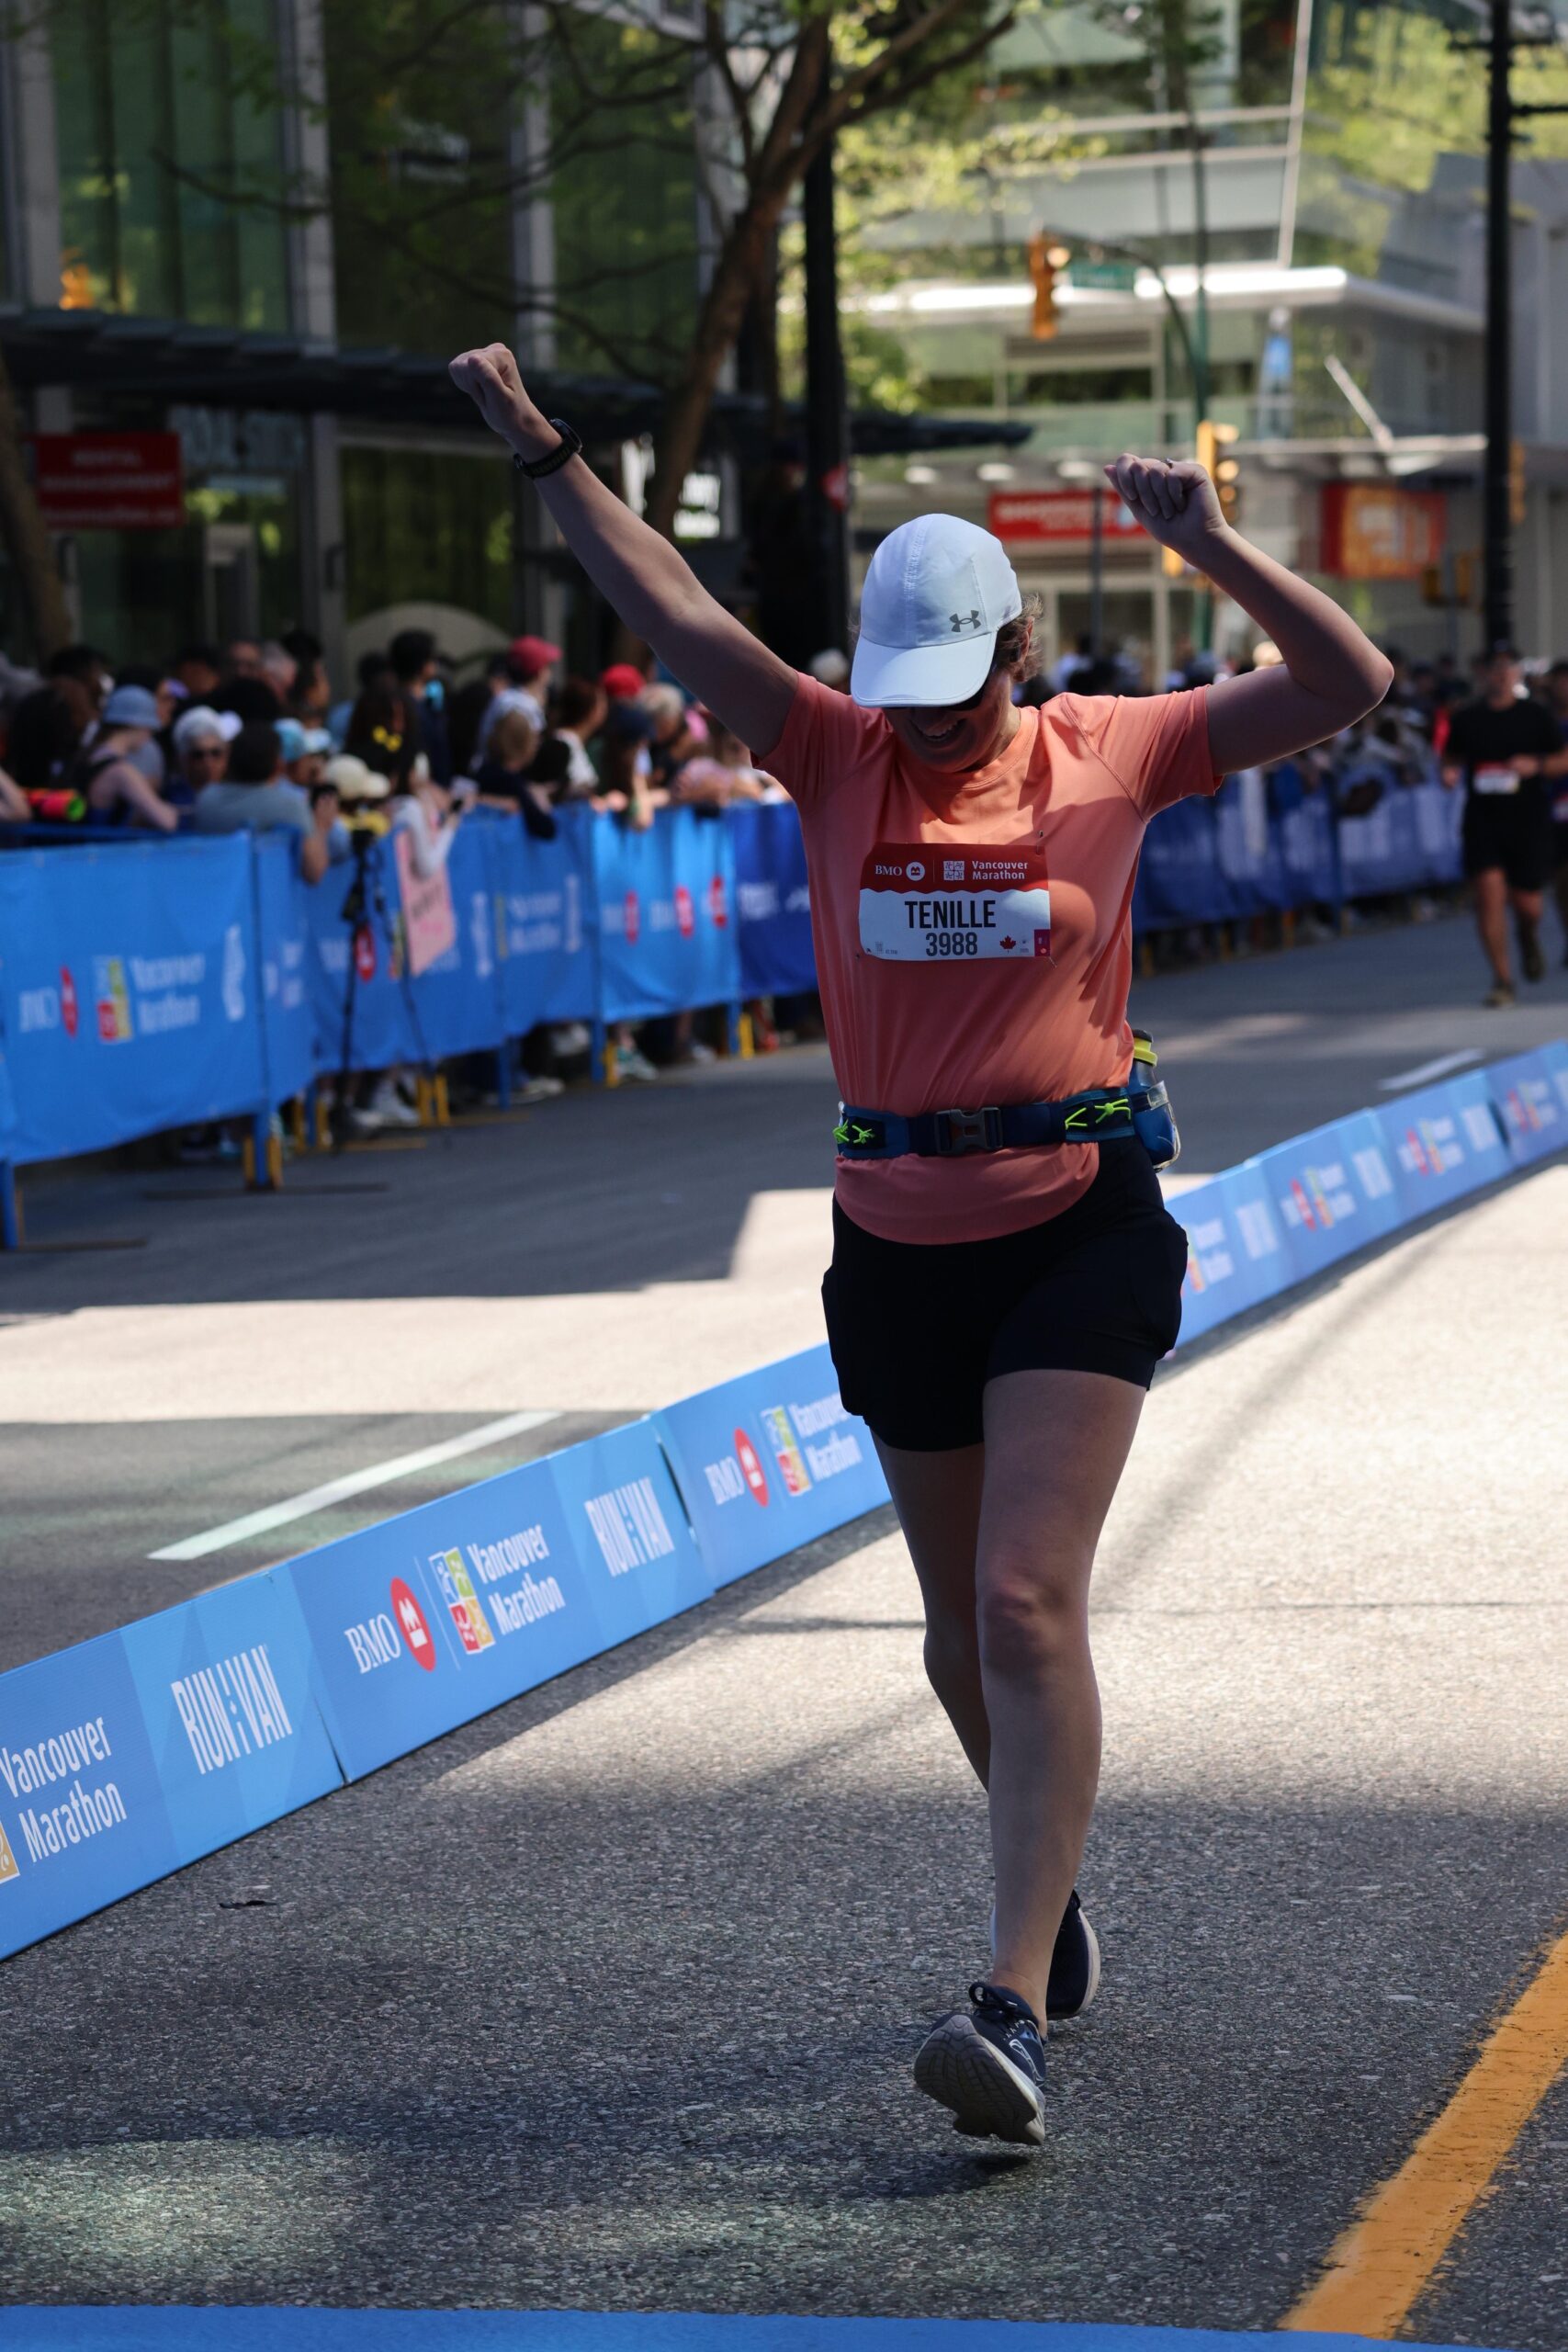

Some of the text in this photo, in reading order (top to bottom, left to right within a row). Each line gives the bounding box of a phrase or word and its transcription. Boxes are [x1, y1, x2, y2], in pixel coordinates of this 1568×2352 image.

[874, 865, 903, 876] BMO
[972, 860, 1029, 870] Vancouver
[972, 870, 1025, 880] Marathon
[904, 899, 997, 929] TENILLE
[925, 932, 978, 956] 3988
[466, 1523, 551, 1585] Vancouver
[488, 1572, 567, 1635] Marathon
[344, 1612, 402, 1675] BMO
[0, 1716, 112, 1799] Vancouver
[18, 1780, 128, 1863] Marathon
